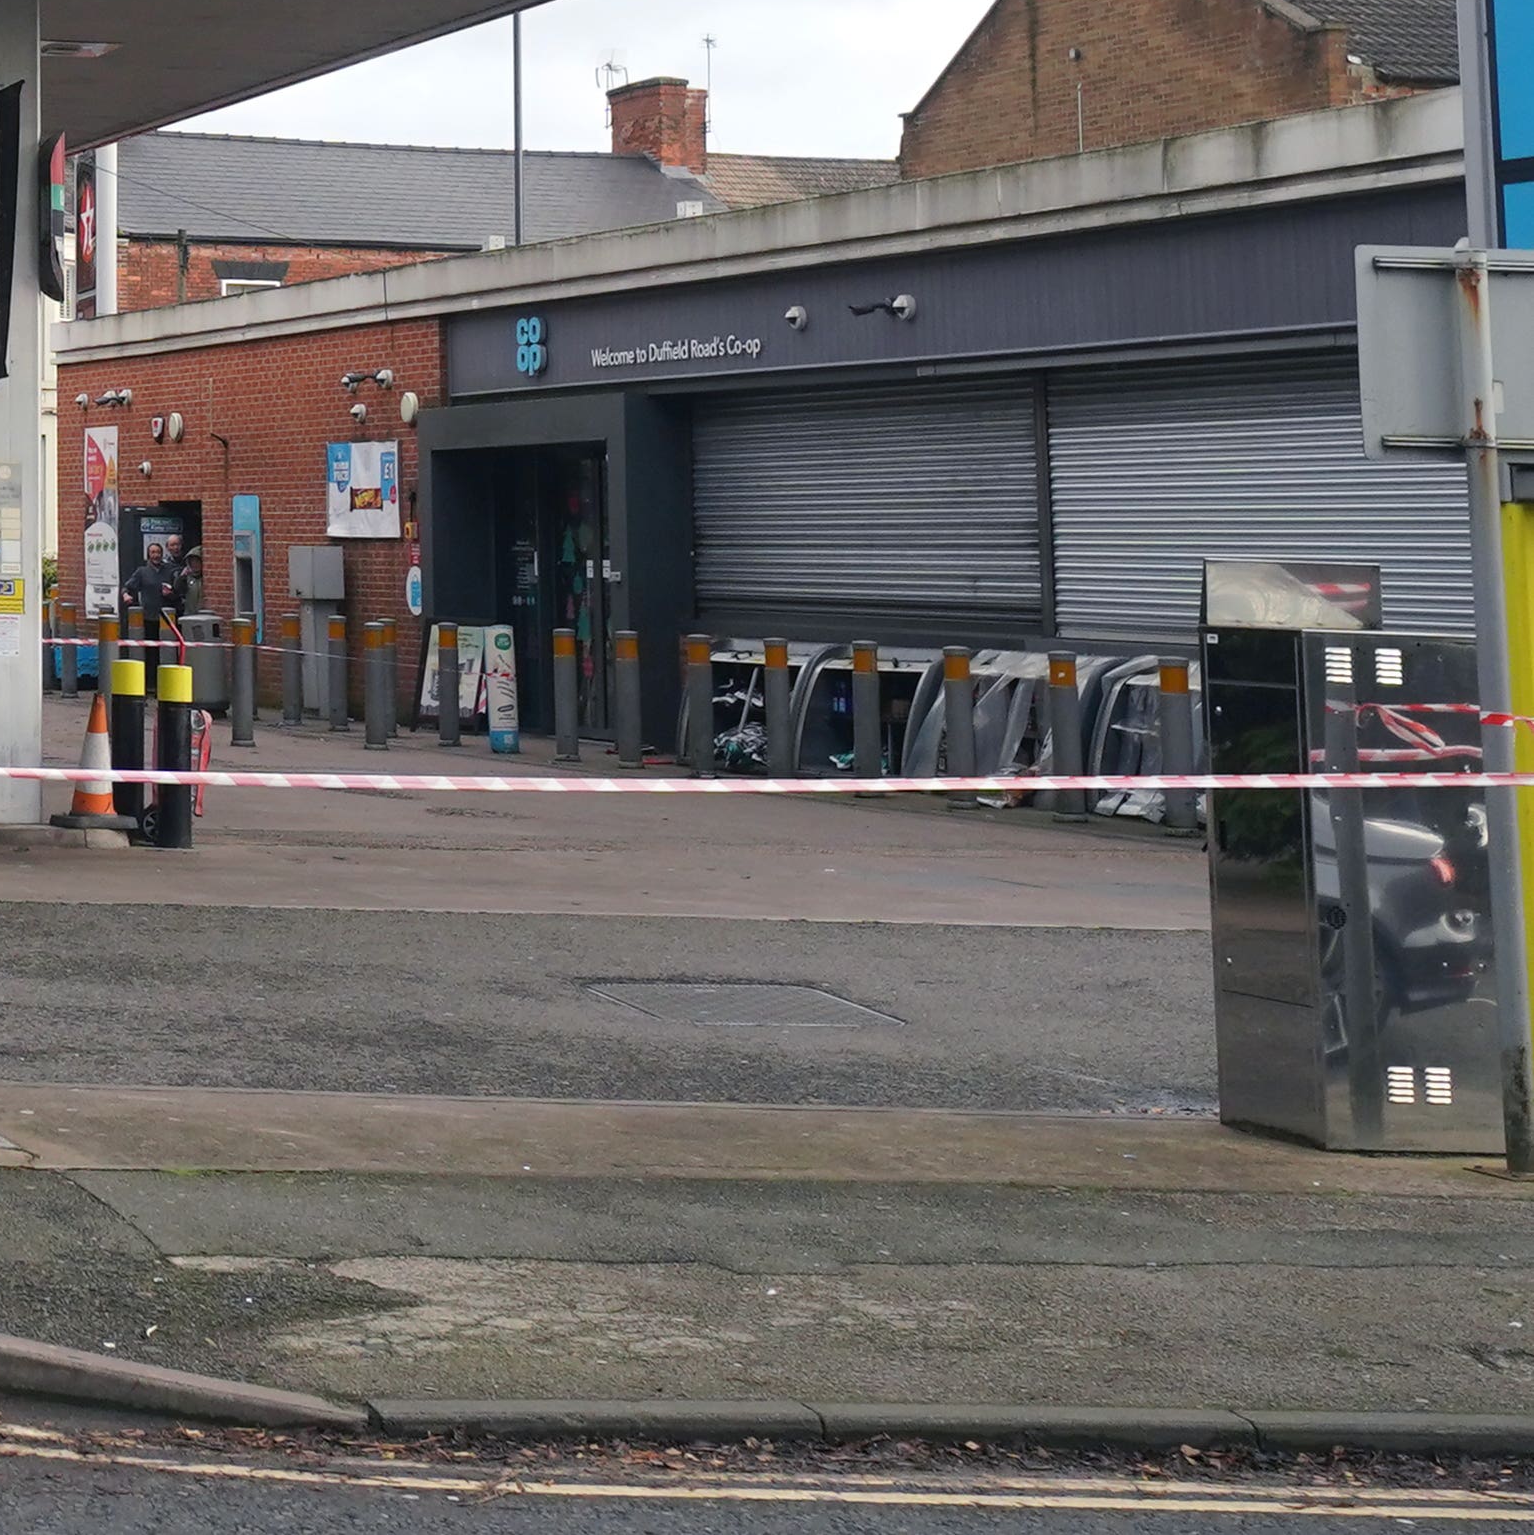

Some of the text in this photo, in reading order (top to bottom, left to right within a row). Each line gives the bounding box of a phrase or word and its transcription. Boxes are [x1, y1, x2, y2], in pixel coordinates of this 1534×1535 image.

[591, 335, 761, 367] Welcome to Duffield Road's Co-op
